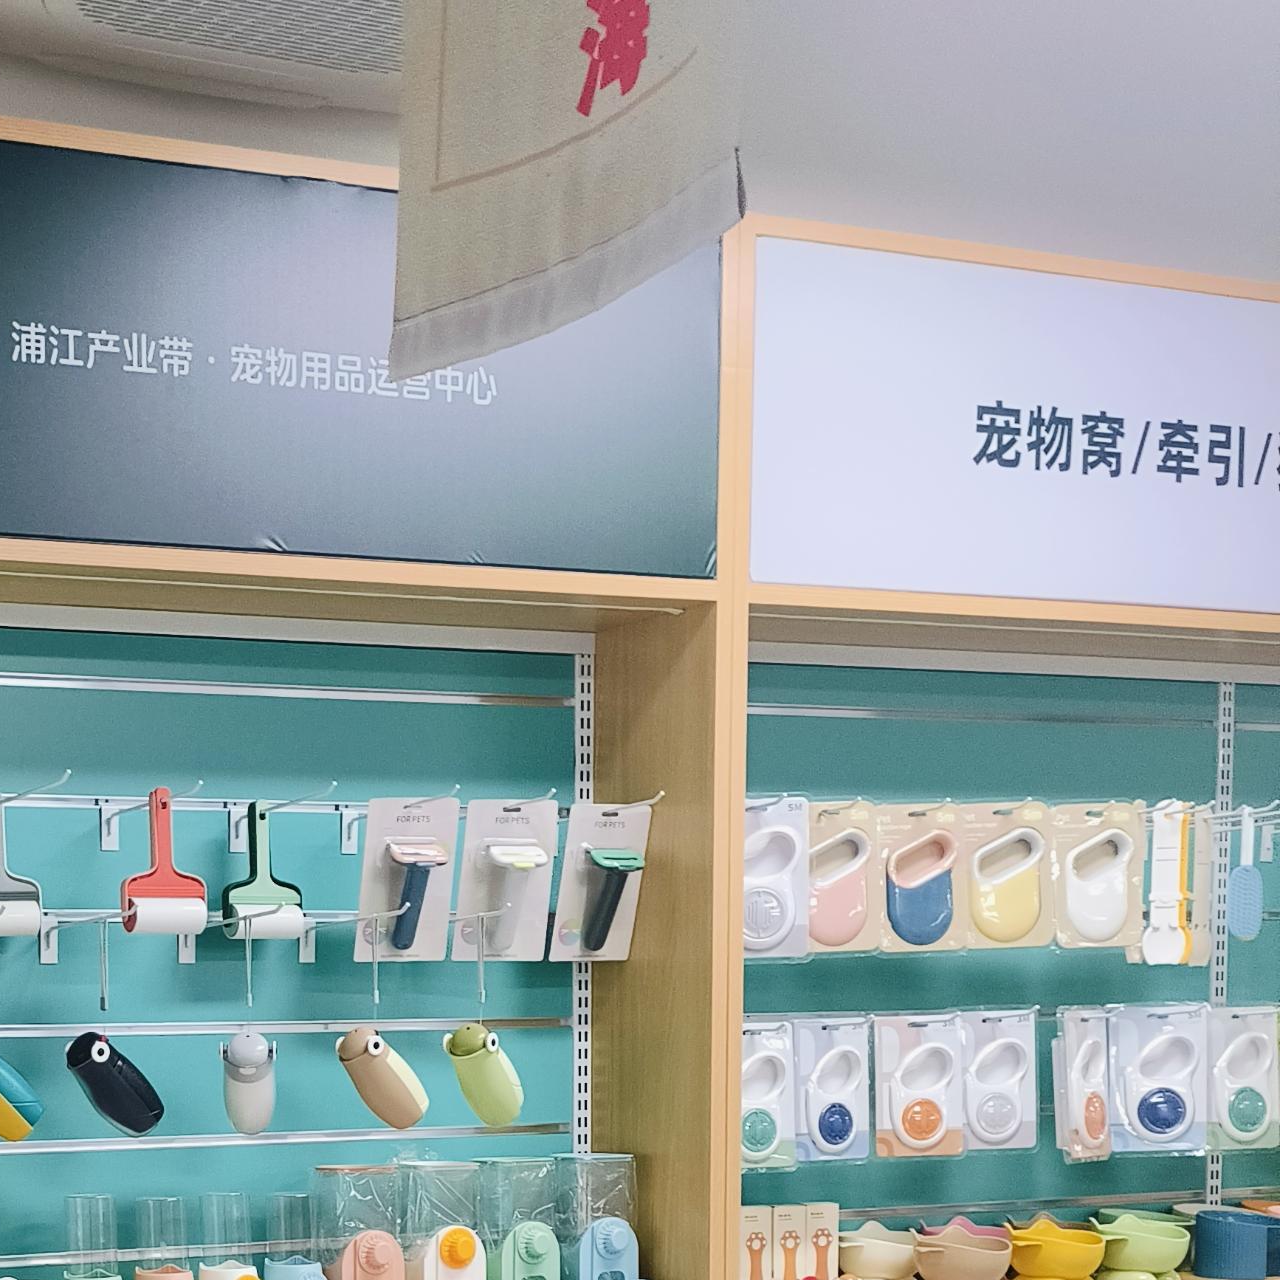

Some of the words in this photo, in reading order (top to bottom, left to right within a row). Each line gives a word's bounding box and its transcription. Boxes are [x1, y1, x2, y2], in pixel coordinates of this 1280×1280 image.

[972, 400, 1280, 492] 宠物窝/牵引/
